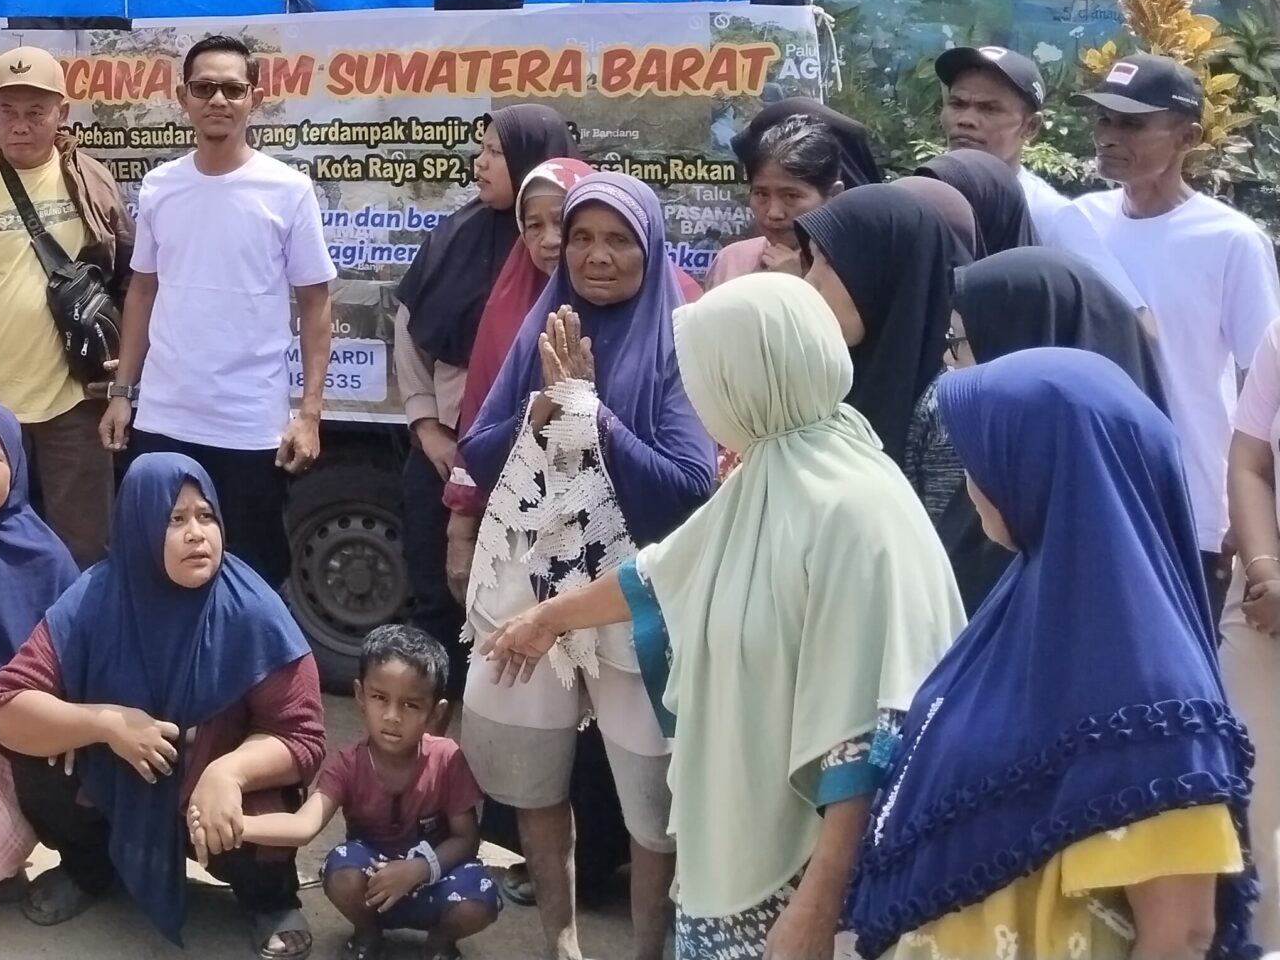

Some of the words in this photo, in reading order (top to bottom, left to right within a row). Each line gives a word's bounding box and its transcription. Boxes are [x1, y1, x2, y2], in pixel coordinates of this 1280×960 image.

[326, 49, 582, 96] SUMATERA
[601, 47, 776, 95] BARAT
[76, 123, 125, 146] beban
[251, 126, 295, 149] yang
[302, 120, 405, 146] terdampak
[412, 119, 468, 146] banjir
[592, 128, 640, 140] Bandang
[318, 157, 362, 178] Kota
[370, 156, 416, 183] Raya
[422, 157, 467, 183] SP2,
[693, 186, 731, 201] Talu
[354, 206, 401, 228] dan
[329, 240, 365, 265] agi
[286, 349, 374, 365] MARDI
